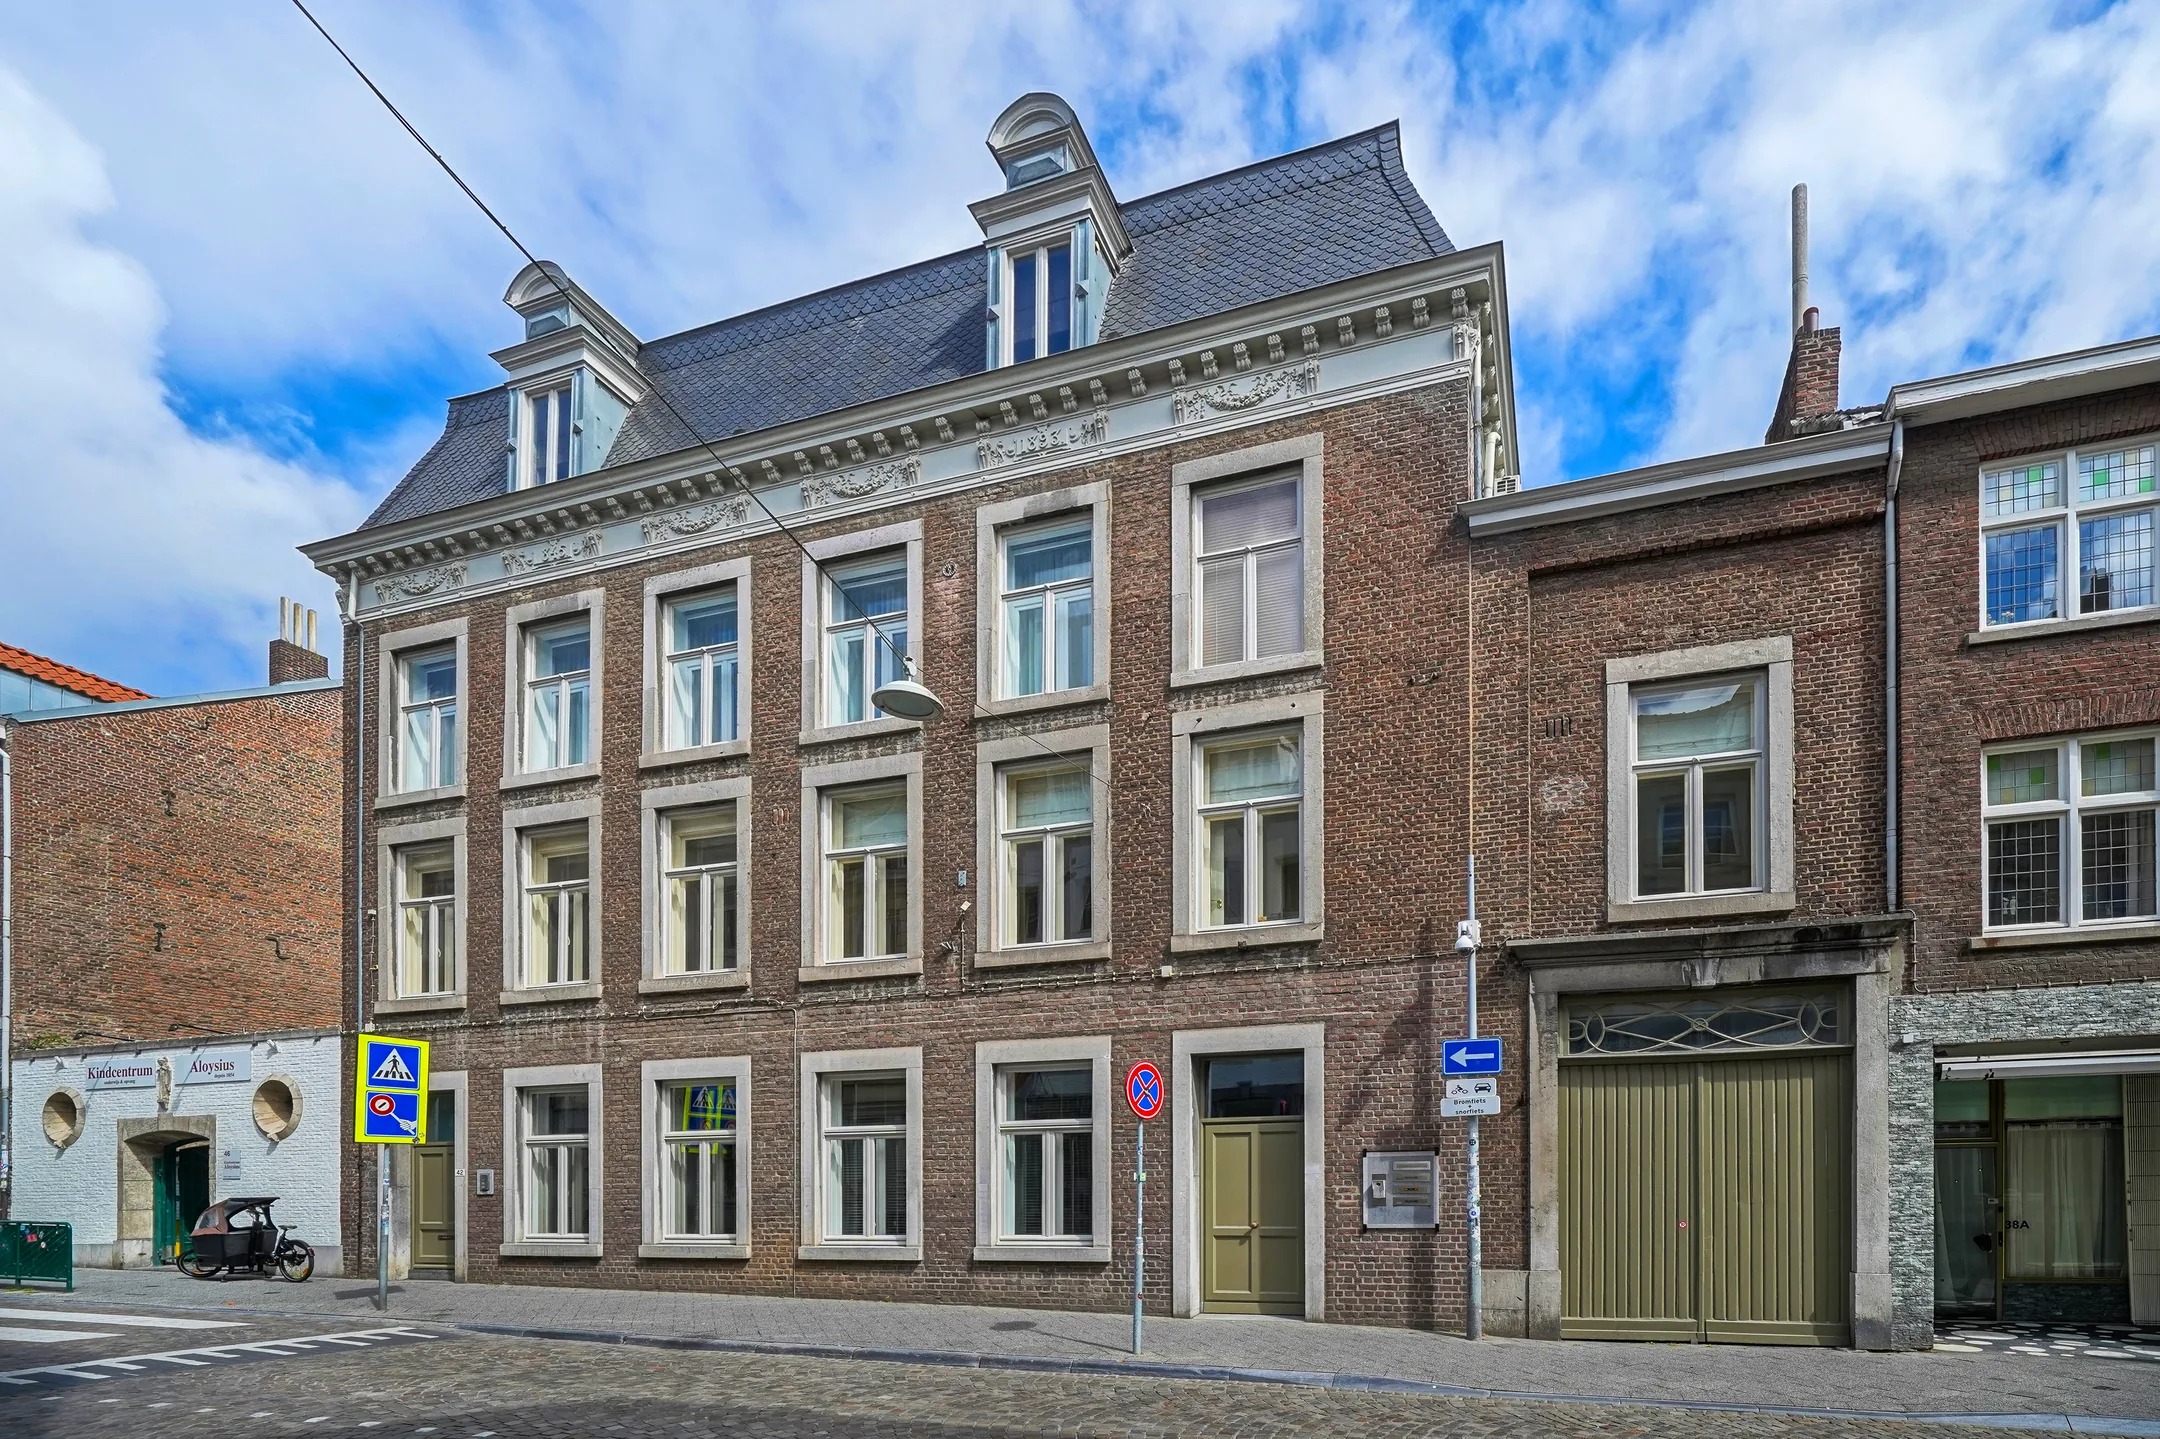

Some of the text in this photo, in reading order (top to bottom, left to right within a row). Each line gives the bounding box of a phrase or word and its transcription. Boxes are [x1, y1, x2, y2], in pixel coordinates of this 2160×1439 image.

[88, 1066, 153, 1079] Kindcentrum
[190, 1059, 235, 1075] Aloysius
[1453, 1098, 1487, 1106] Bromfiets
[2005, 1220, 2030, 1229] 38A
